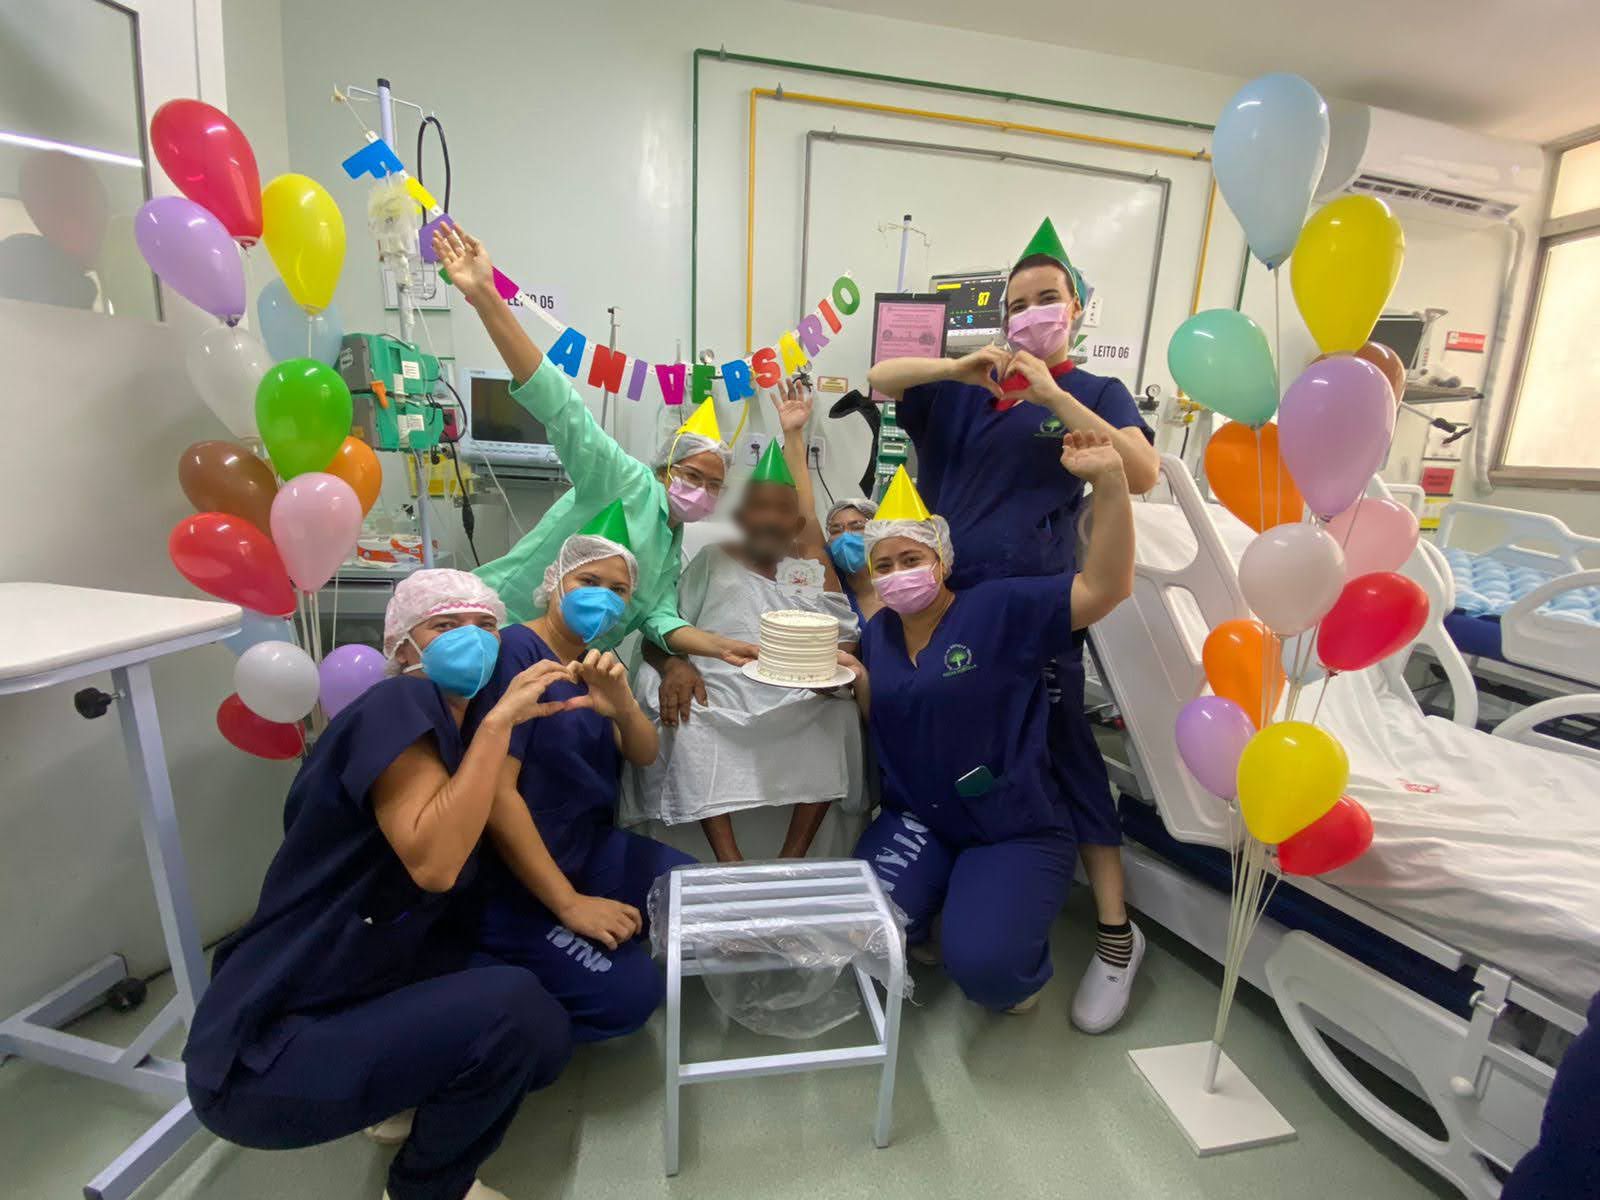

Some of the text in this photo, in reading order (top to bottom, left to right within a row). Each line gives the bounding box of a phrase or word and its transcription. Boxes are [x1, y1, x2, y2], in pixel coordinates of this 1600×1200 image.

[540, 295, 554, 309] 05
[977, 291, 991, 306] 87
[1093, 345, 1130, 359] LEITO 06
